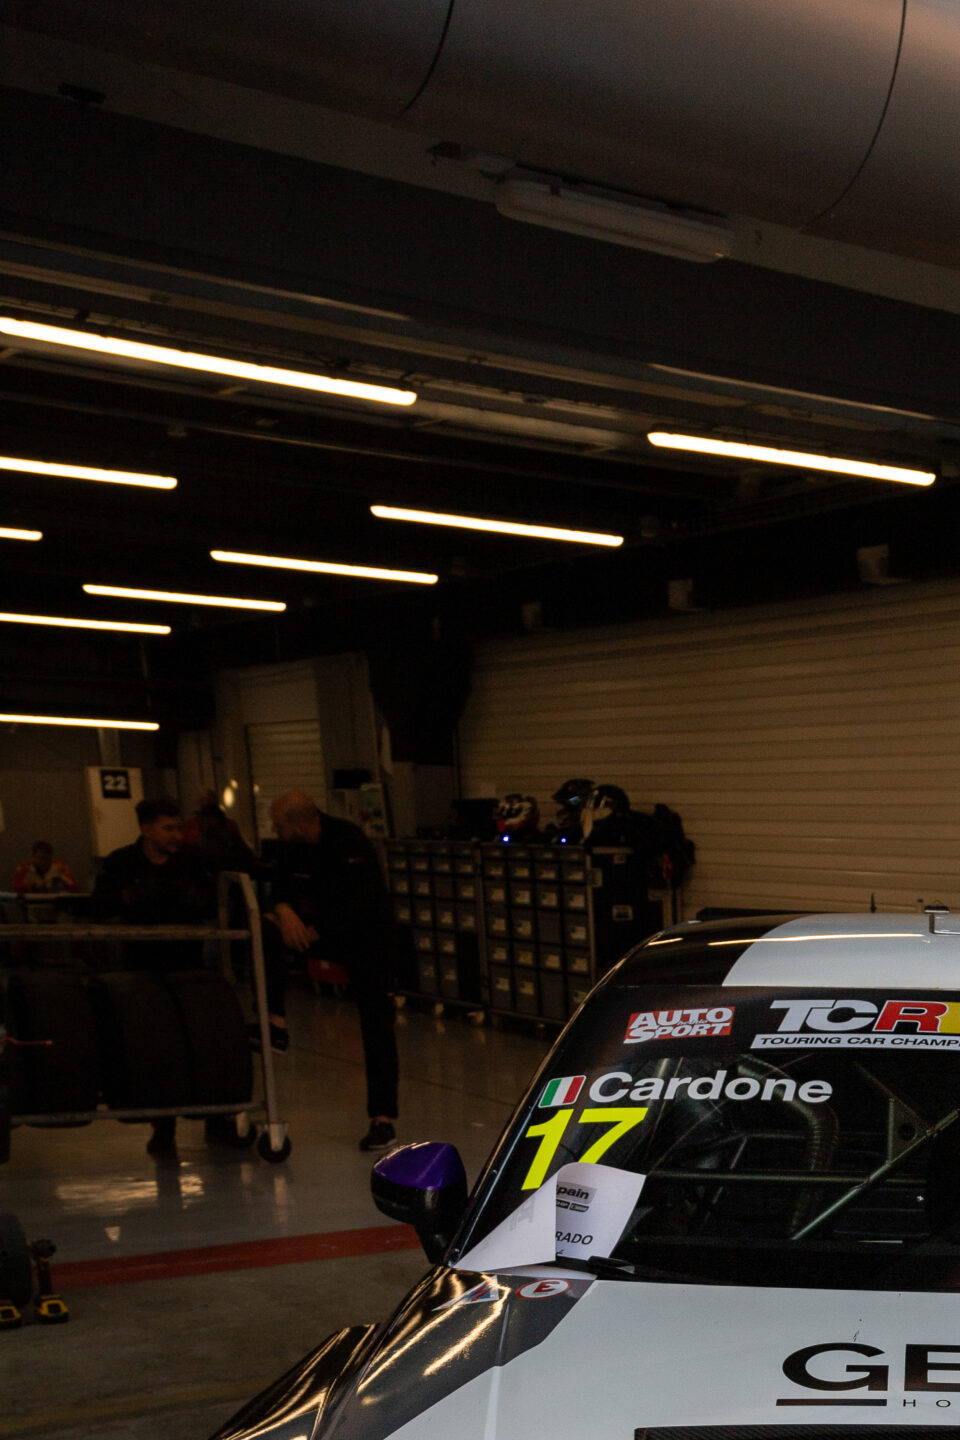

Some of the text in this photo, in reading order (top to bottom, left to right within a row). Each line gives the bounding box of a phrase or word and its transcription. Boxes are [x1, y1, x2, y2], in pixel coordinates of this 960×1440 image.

[103, 774, 128, 791] 22
[629, 1007, 733, 1029] AUTO
[769, 999, 950, 1033] TCR
[623, 1022, 731, 1044] SPORT
[760, 1037, 841, 1045] TOURING
[847, 1037, 886, 1045] CAR
[588, 1070, 833, 1103] Cardone
[520, 1107, 649, 1191] 17
[556, 1185, 590, 1200] pain
